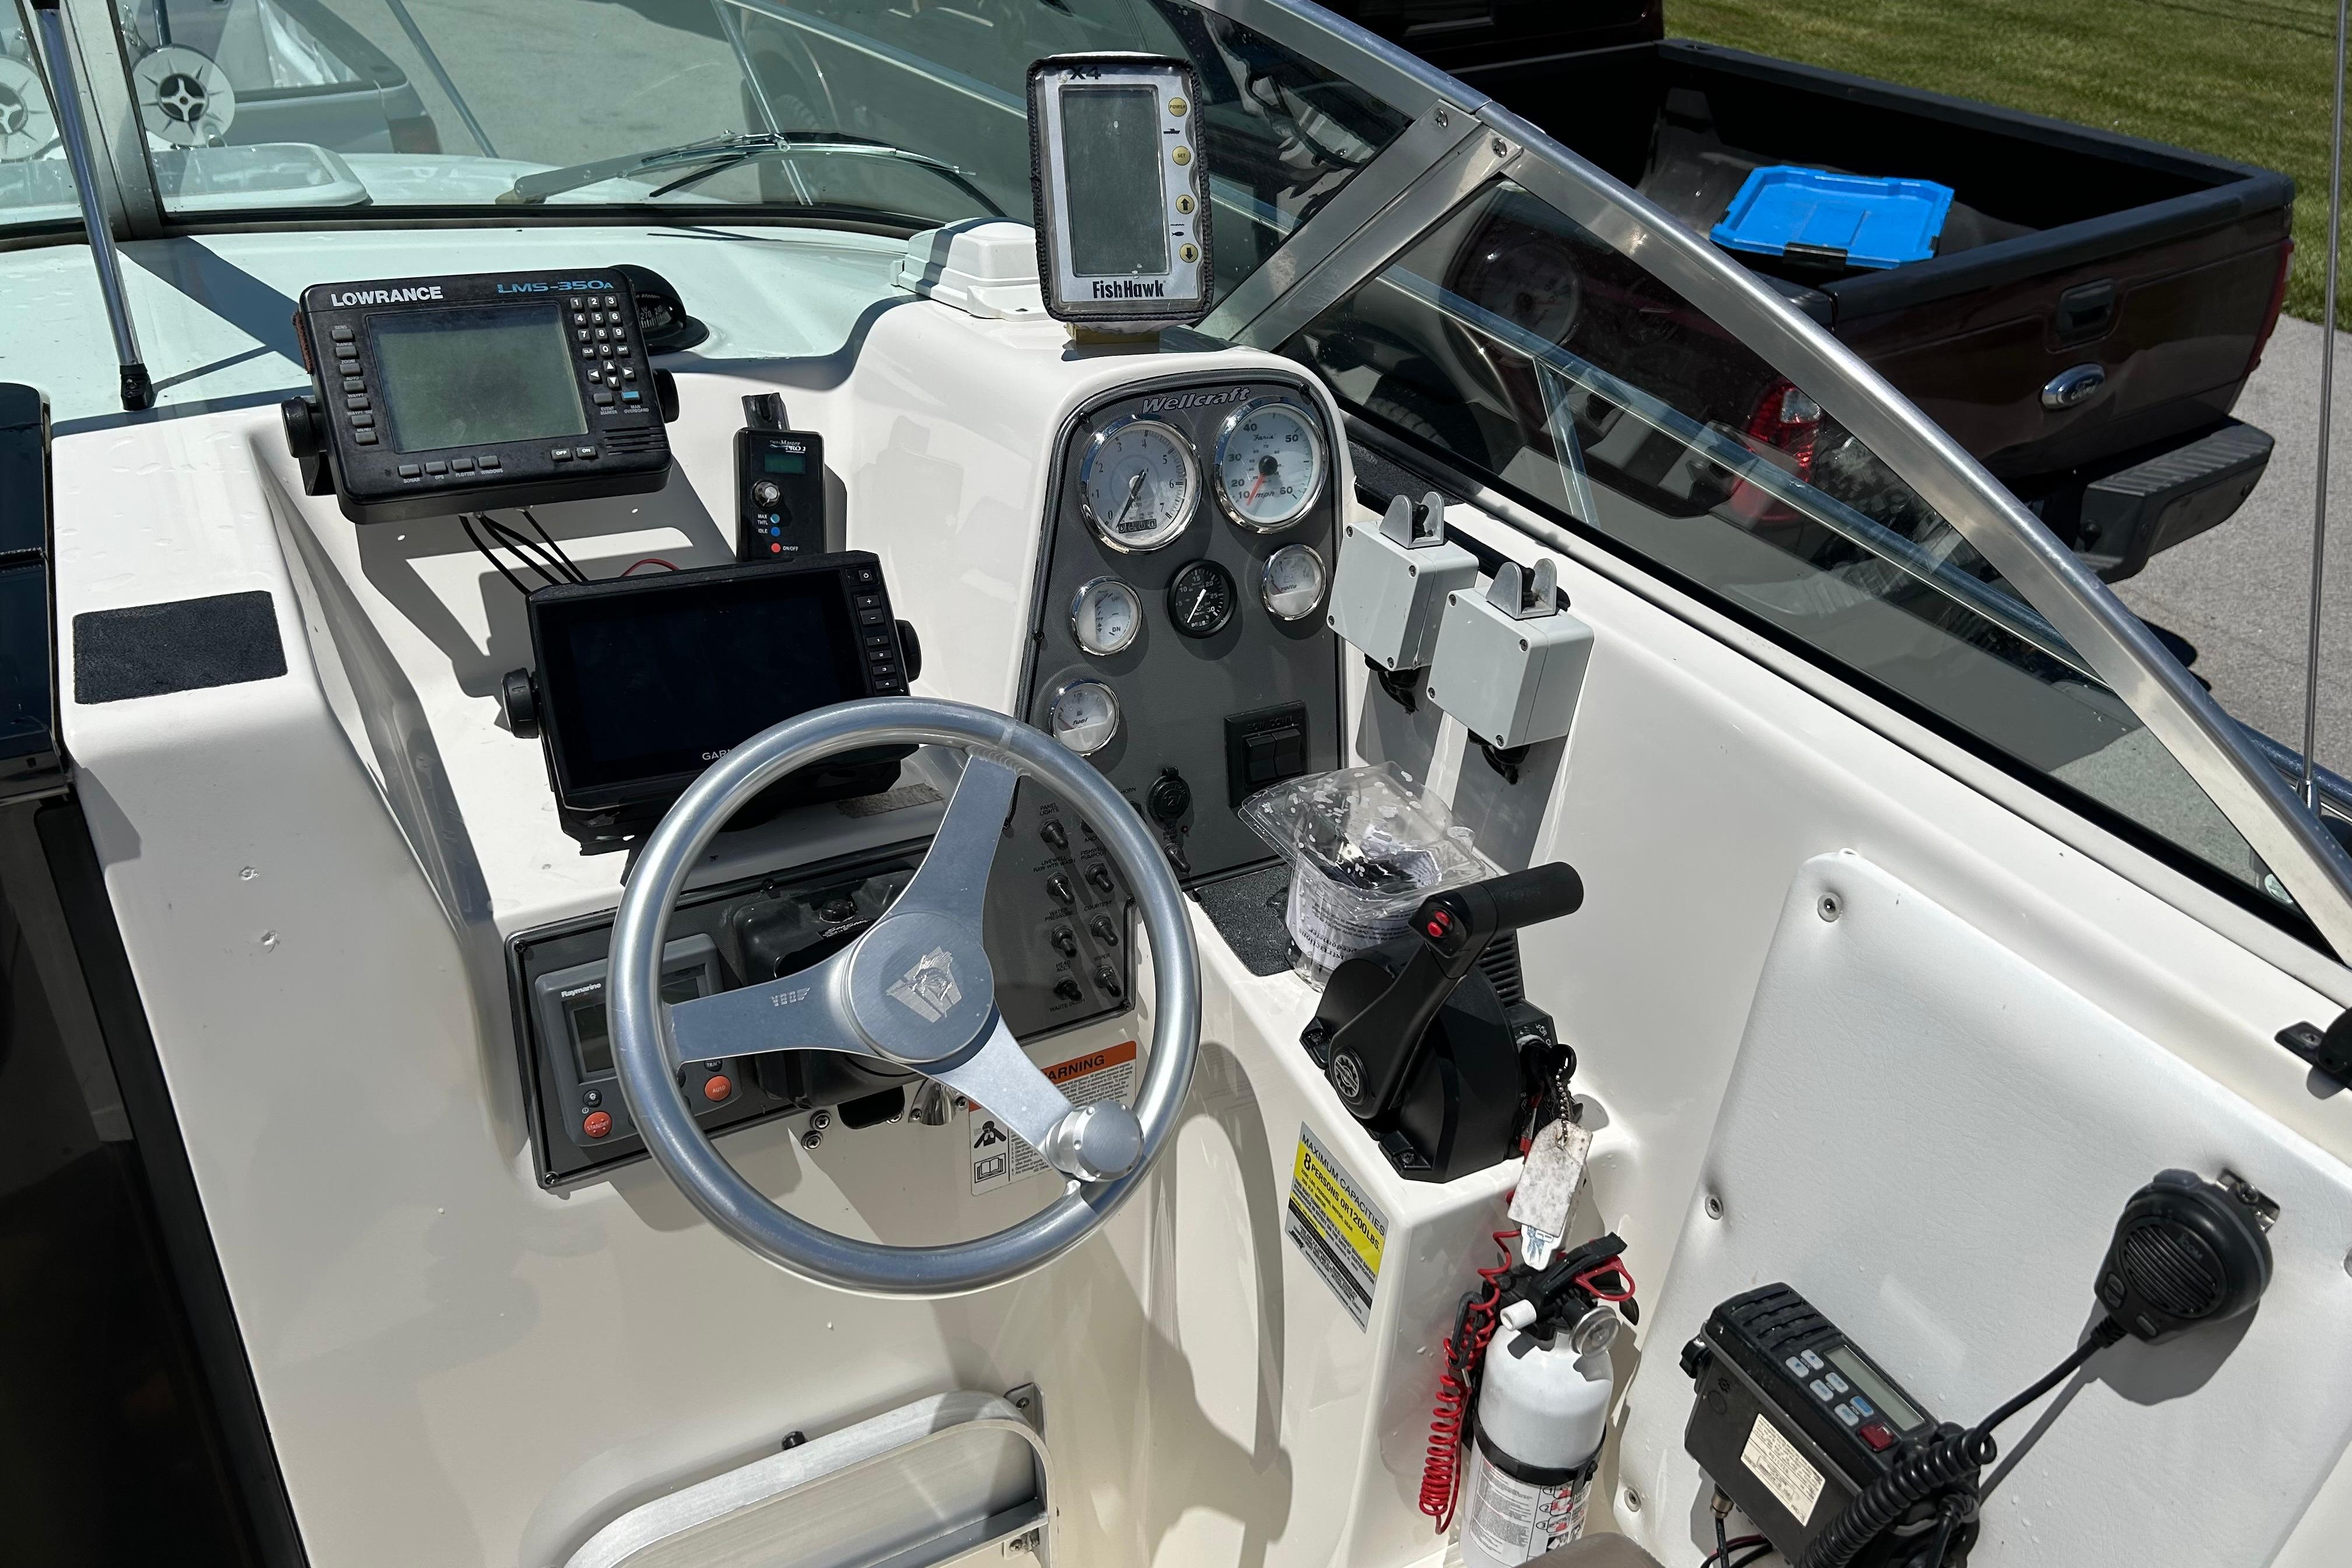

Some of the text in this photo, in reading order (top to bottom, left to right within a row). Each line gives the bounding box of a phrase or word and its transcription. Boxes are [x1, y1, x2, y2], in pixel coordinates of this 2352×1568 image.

[1070, 66, 1101, 79] X4
[497, 280, 614, 294] LMS-350A
[1093, 280, 1164, 299] FishHawk
[331, 286, 444, 307] LOWRANCE
[1142, 387, 1251, 414] Wellcraft
[1243, 424, 1257, 432] 40
[1142, 438, 1147, 449] 4
[1285, 434, 1298, 443] 50
[1116, 442, 1122, 452] 3
[1163, 454, 1167, 465] 5
[1228, 453, 1241, 462] 30
[1098, 463, 1104, 473] 2
[1169, 478, 1174, 489] 6
[1231, 479, 1245, 487] 20
[1096, 489, 1100, 498] 1
[1238, 491, 1250, 499] 10
[1255, 491, 1275, 499] mph
[1280, 486, 1293, 495] 60
[1159, 502, 1165, 512] 7
[1108, 510, 1113, 520] 0
[1072, 718, 1088, 726] fuel
[702, 749, 730, 760] GAR
[1040, 802, 1058, 811] PANEL
[1040, 807, 1060, 816] LIGHTS
[1041, 856, 1067, 865] LIVEWELL
[1083, 900, 1112, 911] COURTESY
[1044, 910, 1073, 922] PRESSURE
[1049, 907, 1068, 916] WATER
[1297, 928, 1345, 961] structions
[561, 982, 601, 998] Raymarine
[1049, 1002, 1068, 1013] WASTE
[1044, 1055, 1105, 1080] ARNING
[1301, 1132, 1339, 1182] MAXIMUM
[1339, 1176, 1385, 1237] CAPACITIES
[1303, 1150, 1381, 1253] 8 PERSONS OR 1200 LBS.
